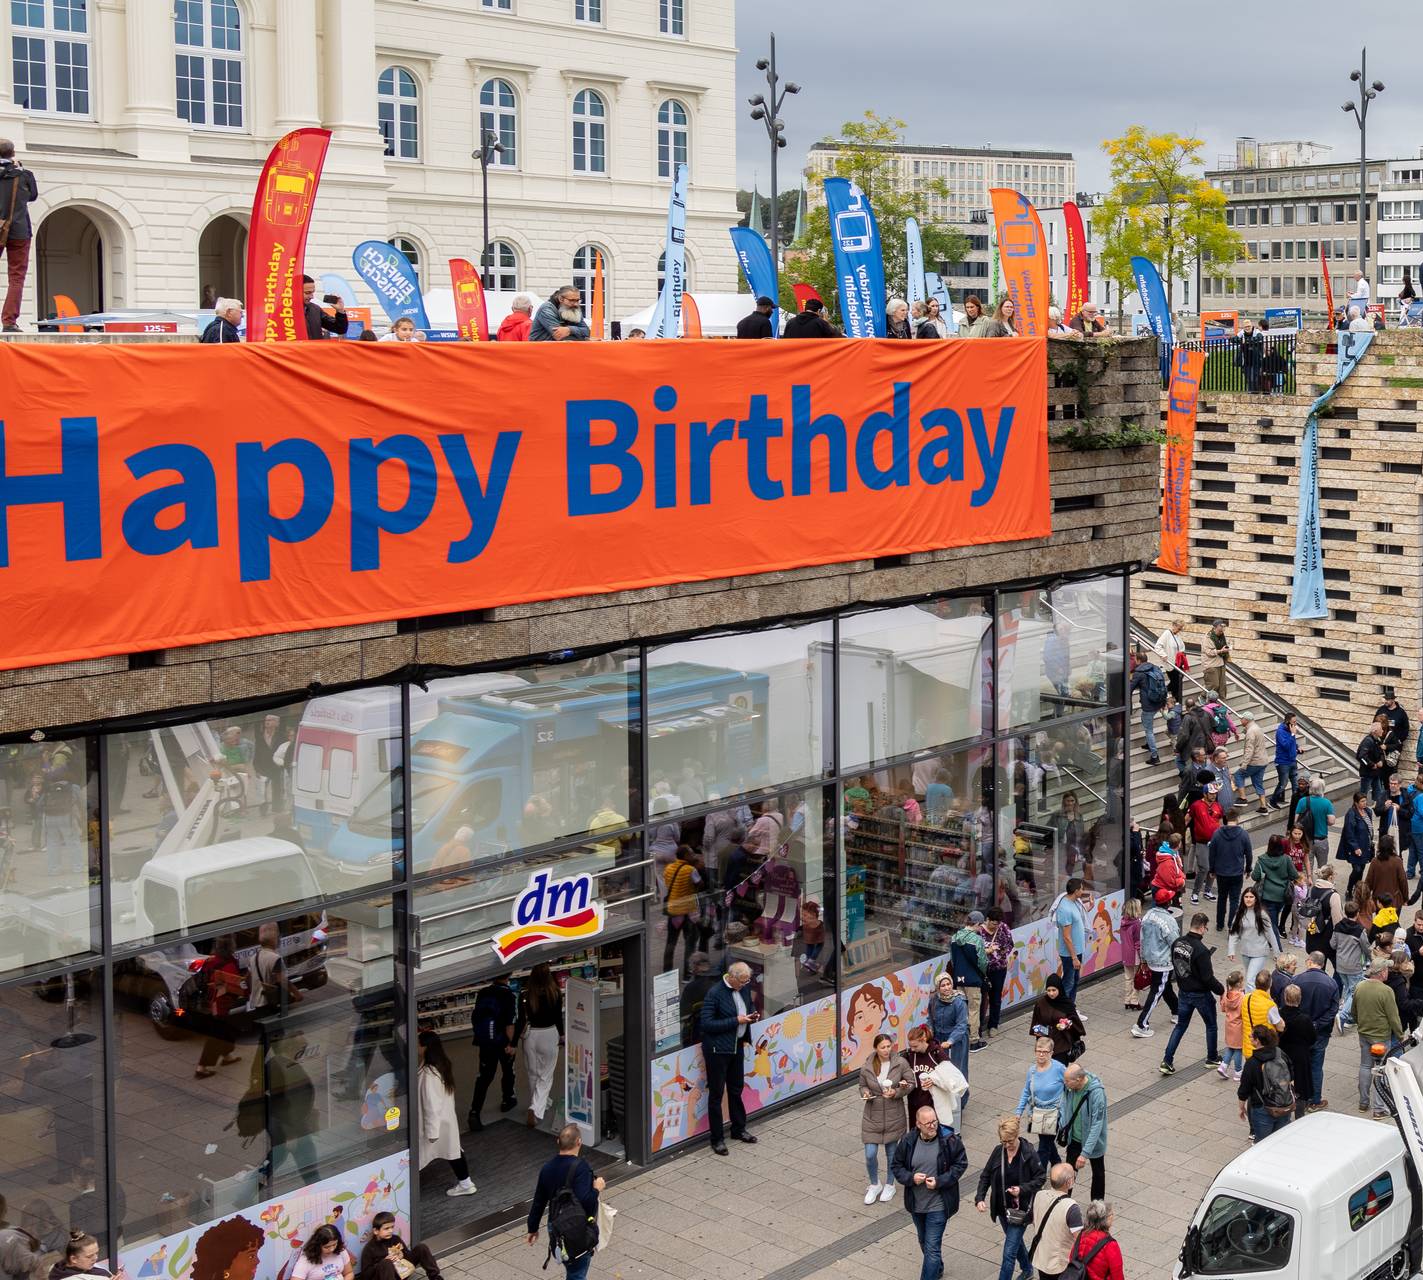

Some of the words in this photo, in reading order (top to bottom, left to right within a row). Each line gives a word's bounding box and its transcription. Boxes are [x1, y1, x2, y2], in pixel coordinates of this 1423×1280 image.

[263, 242, 285, 314] Birthday
[279, 256, 297, 342] webebahn
[0, 418, 521, 581] Happy
[567, 382, 1014, 515] Birthday
[517, 874, 590, 926] dm
